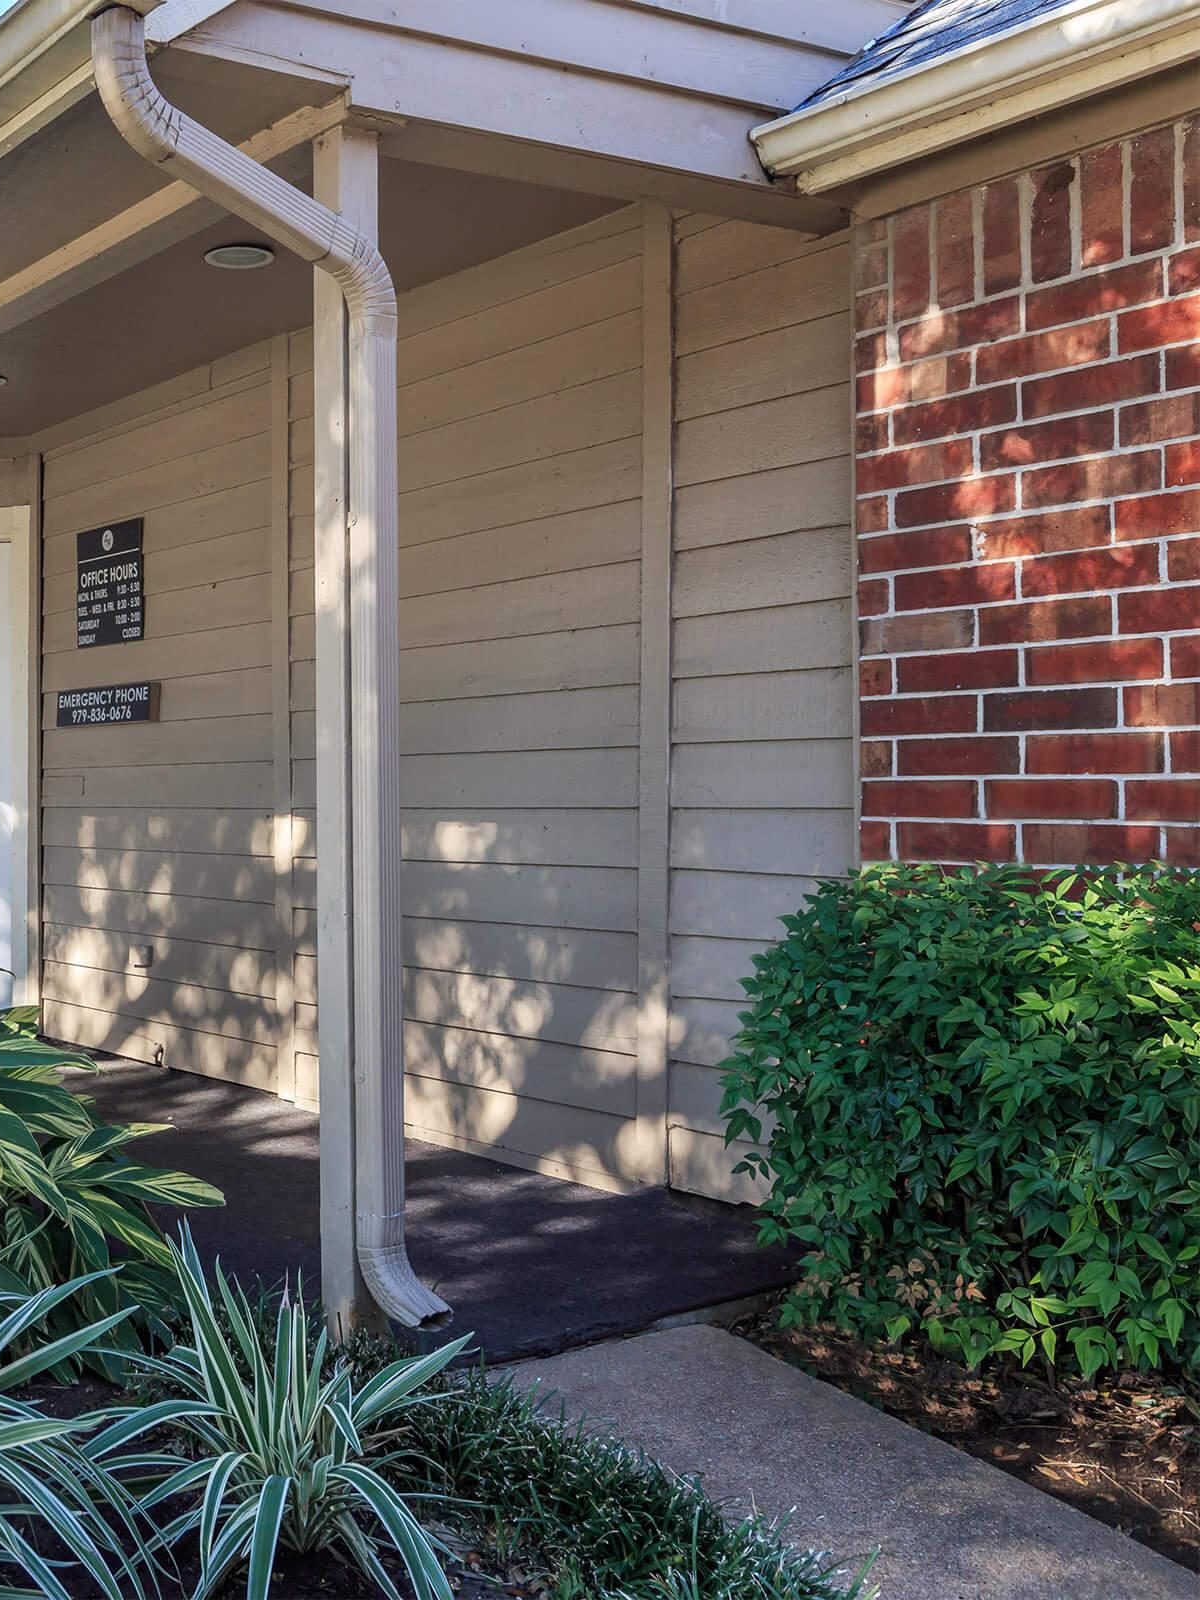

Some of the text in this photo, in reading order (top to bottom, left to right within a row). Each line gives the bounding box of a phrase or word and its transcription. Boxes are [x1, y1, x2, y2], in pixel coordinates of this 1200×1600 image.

[80, 562, 138, 588] OFFICE HOURS
[130, 581, 140, 592] 5:30
[116, 599, 127, 610] 8:30
[130, 596, 140, 607] 5:30
[78, 619, 100, 631] SATURDAY
[115, 613, 127, 625] 10:00
[130, 611, 140, 622] 2:00
[78, 627, 140, 645] SUNDAY CLOSED
[59, 686, 149, 709] EMERGENCY PHONE
[72, 705, 132, 723] 979-836-0676
